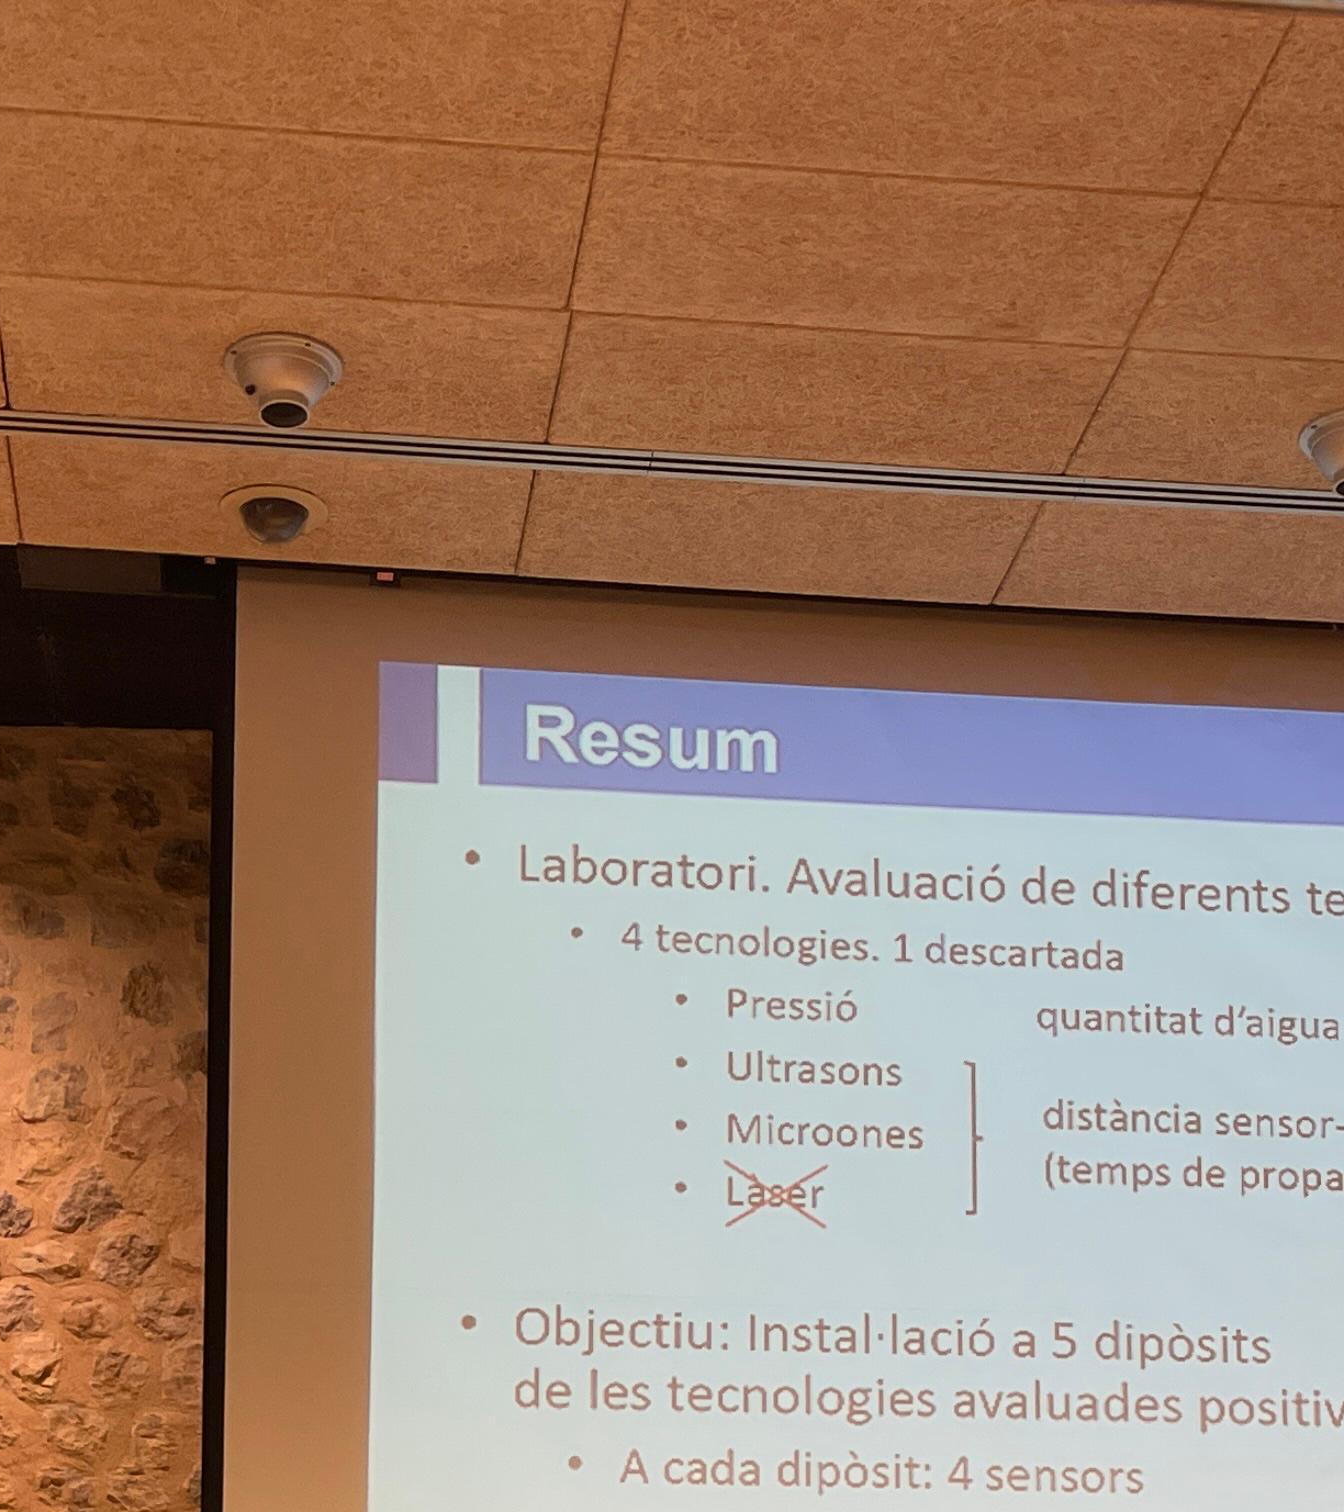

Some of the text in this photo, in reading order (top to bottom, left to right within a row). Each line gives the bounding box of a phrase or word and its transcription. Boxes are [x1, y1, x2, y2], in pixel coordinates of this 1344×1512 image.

[526, 704, 777, 773] Resum
[520, 843, 770, 893] Laboratori.
[786, 857, 1006, 903] Avaluació
[1021, 865, 1075, 906] de
[1092, 867, 1291, 914] diferents
[621, 922, 1124, 971] 4 tecnologies. 1 descartada
[727, 988, 858, 1023] Pressió
[1036, 1003, 1203, 1041] quantitat
[727, 1050, 902, 1087] Ultrasons
[727, 1113, 924, 1150] Microones
[1043, 1098, 1202, 1135] distància
[1045, 1151, 1171, 1193] (temps
[1183, 1155, 1226, 1188] de
[515, 1303, 729, 1356] Objectiu:
[1012, 1330, 1036, 1358] a
[1052, 1321, 1077, 1359] 5
[1095, 1319, 1271, 1371] dipòsits
[514, 1367, 572, 1410] de
[590, 1368, 652, 1411] les
[666, 1373, 937, 1426] tecnologies
[953, 1379, 1183, 1424] avaluades
[619, 1447, 1144, 1497] A cada dipòsit: 4 sensors
